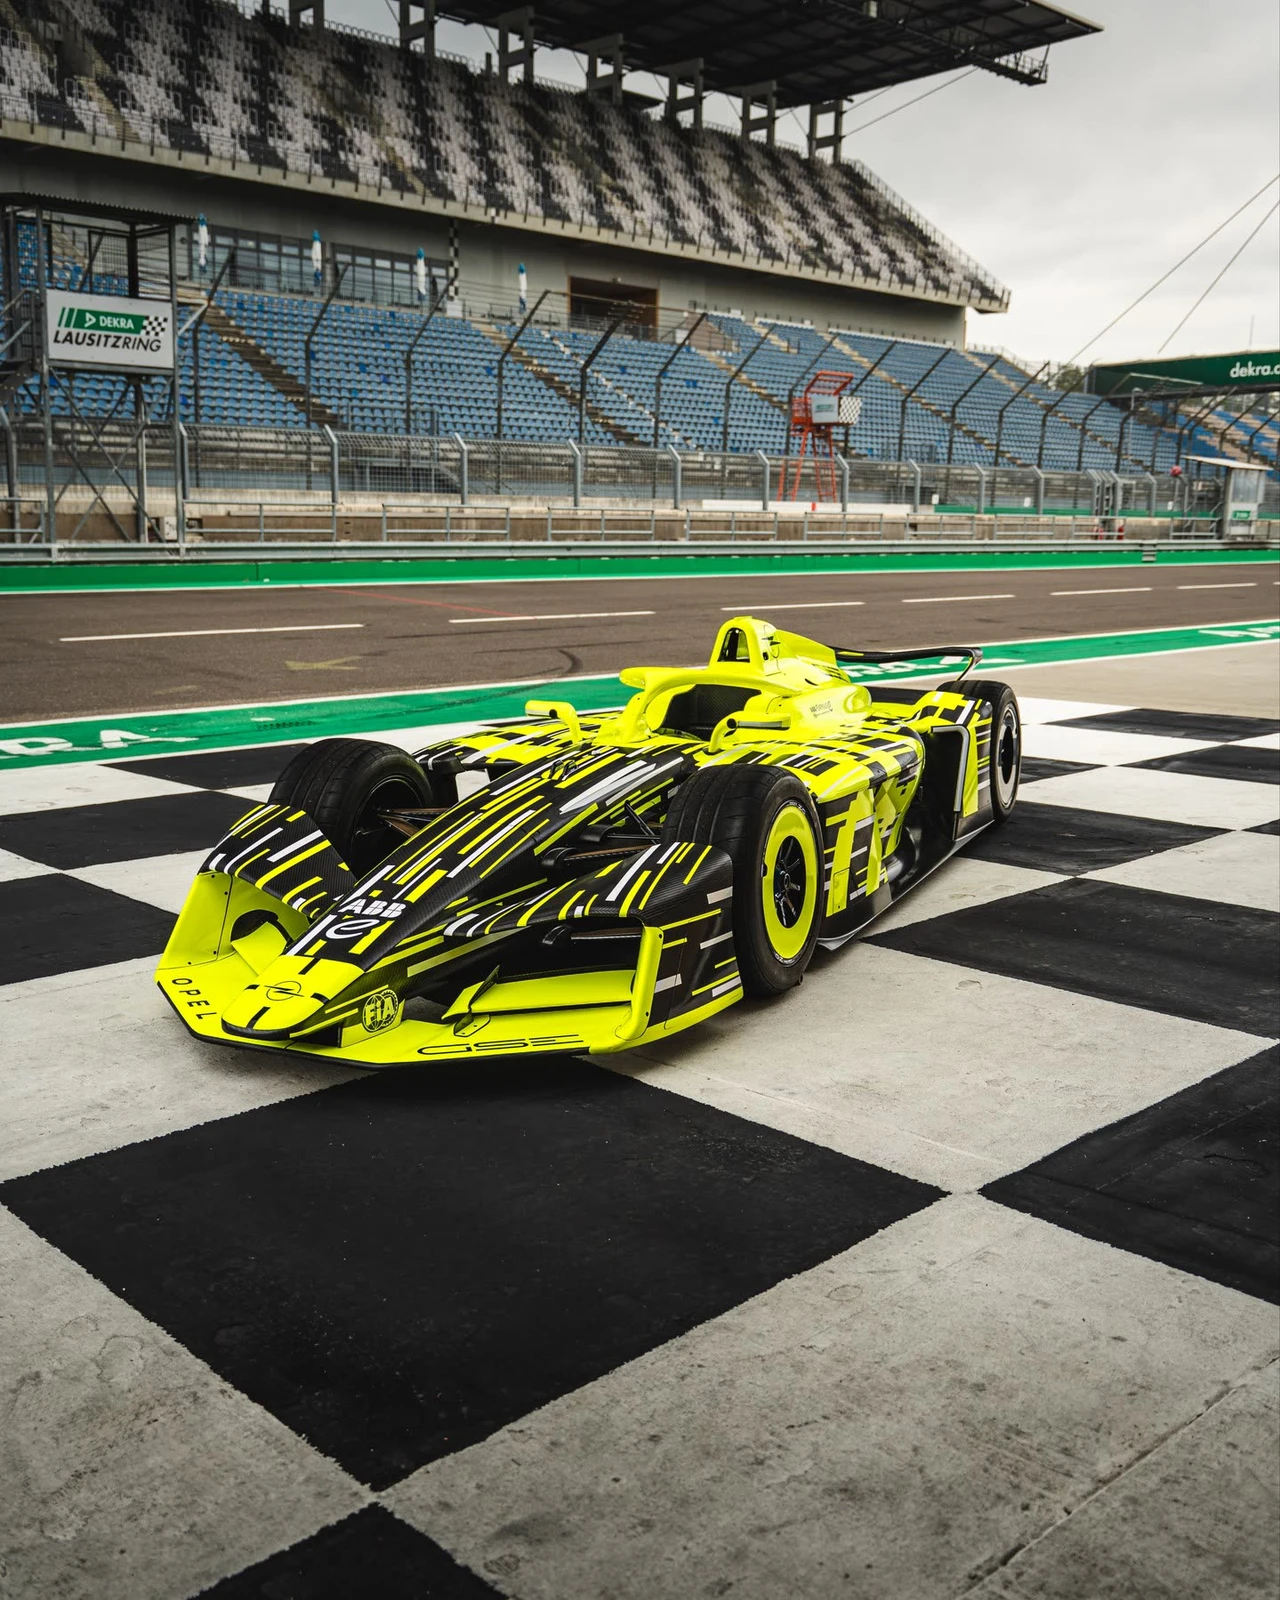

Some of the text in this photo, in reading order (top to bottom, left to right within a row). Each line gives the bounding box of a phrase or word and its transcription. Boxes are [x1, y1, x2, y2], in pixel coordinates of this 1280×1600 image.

[99, 315, 135, 329] DEKRA
[53, 330, 161, 352] LAUSITZRING
[338, 899, 406, 918] ABB
[172, 978, 217, 1020] OPEL
